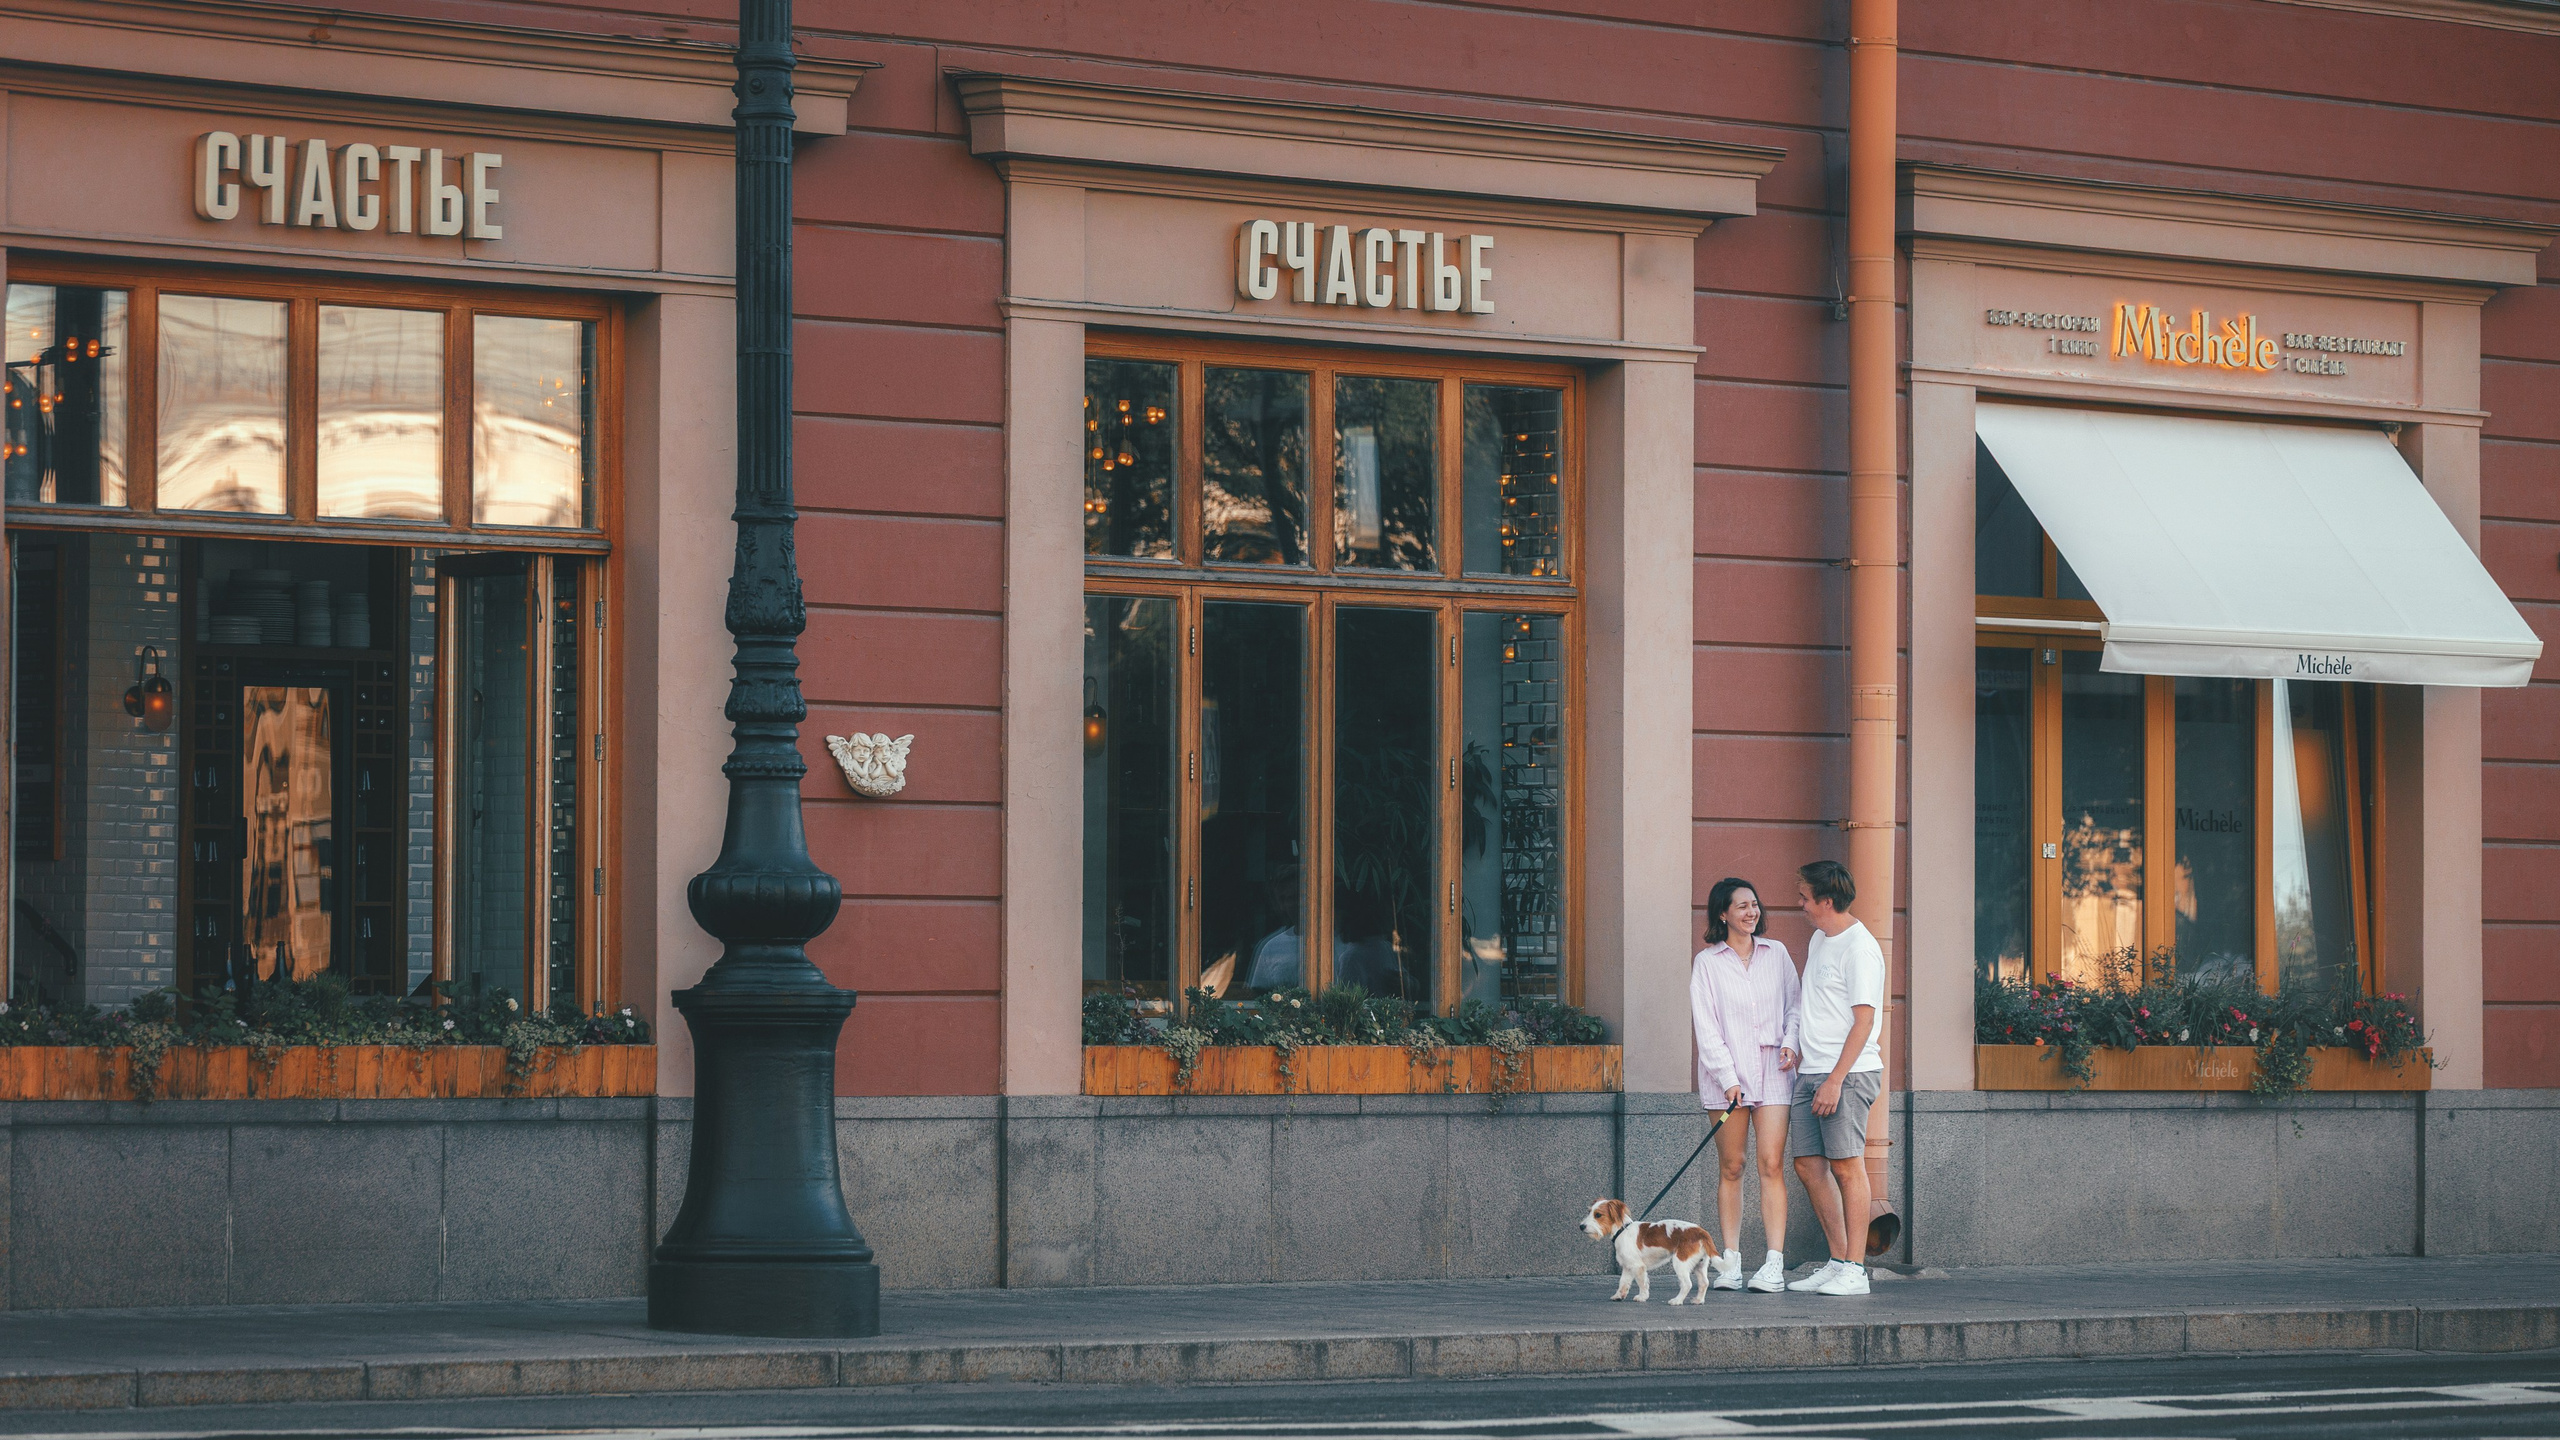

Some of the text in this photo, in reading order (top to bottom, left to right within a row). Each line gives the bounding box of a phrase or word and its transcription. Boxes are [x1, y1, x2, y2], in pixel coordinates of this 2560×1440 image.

[196, 131, 503, 240] СЧАСТЬЕ
[1239, 219, 1496, 314] СЧАСТЬЕ
[1987, 309, 2101, 333] БАР-РЕСТОРАН
[2060, 339, 2099, 356] КИНО
[2118, 305, 2280, 369] Michèle
[2285, 332, 2408, 356] BAR-RESTAURANT
[2296, 354, 2349, 375] CINÉMA
[2296, 654, 2352, 675] Michèle
[2175, 808, 2243, 833] Michèle
[2184, 1059, 2239, 1078] Michèle
